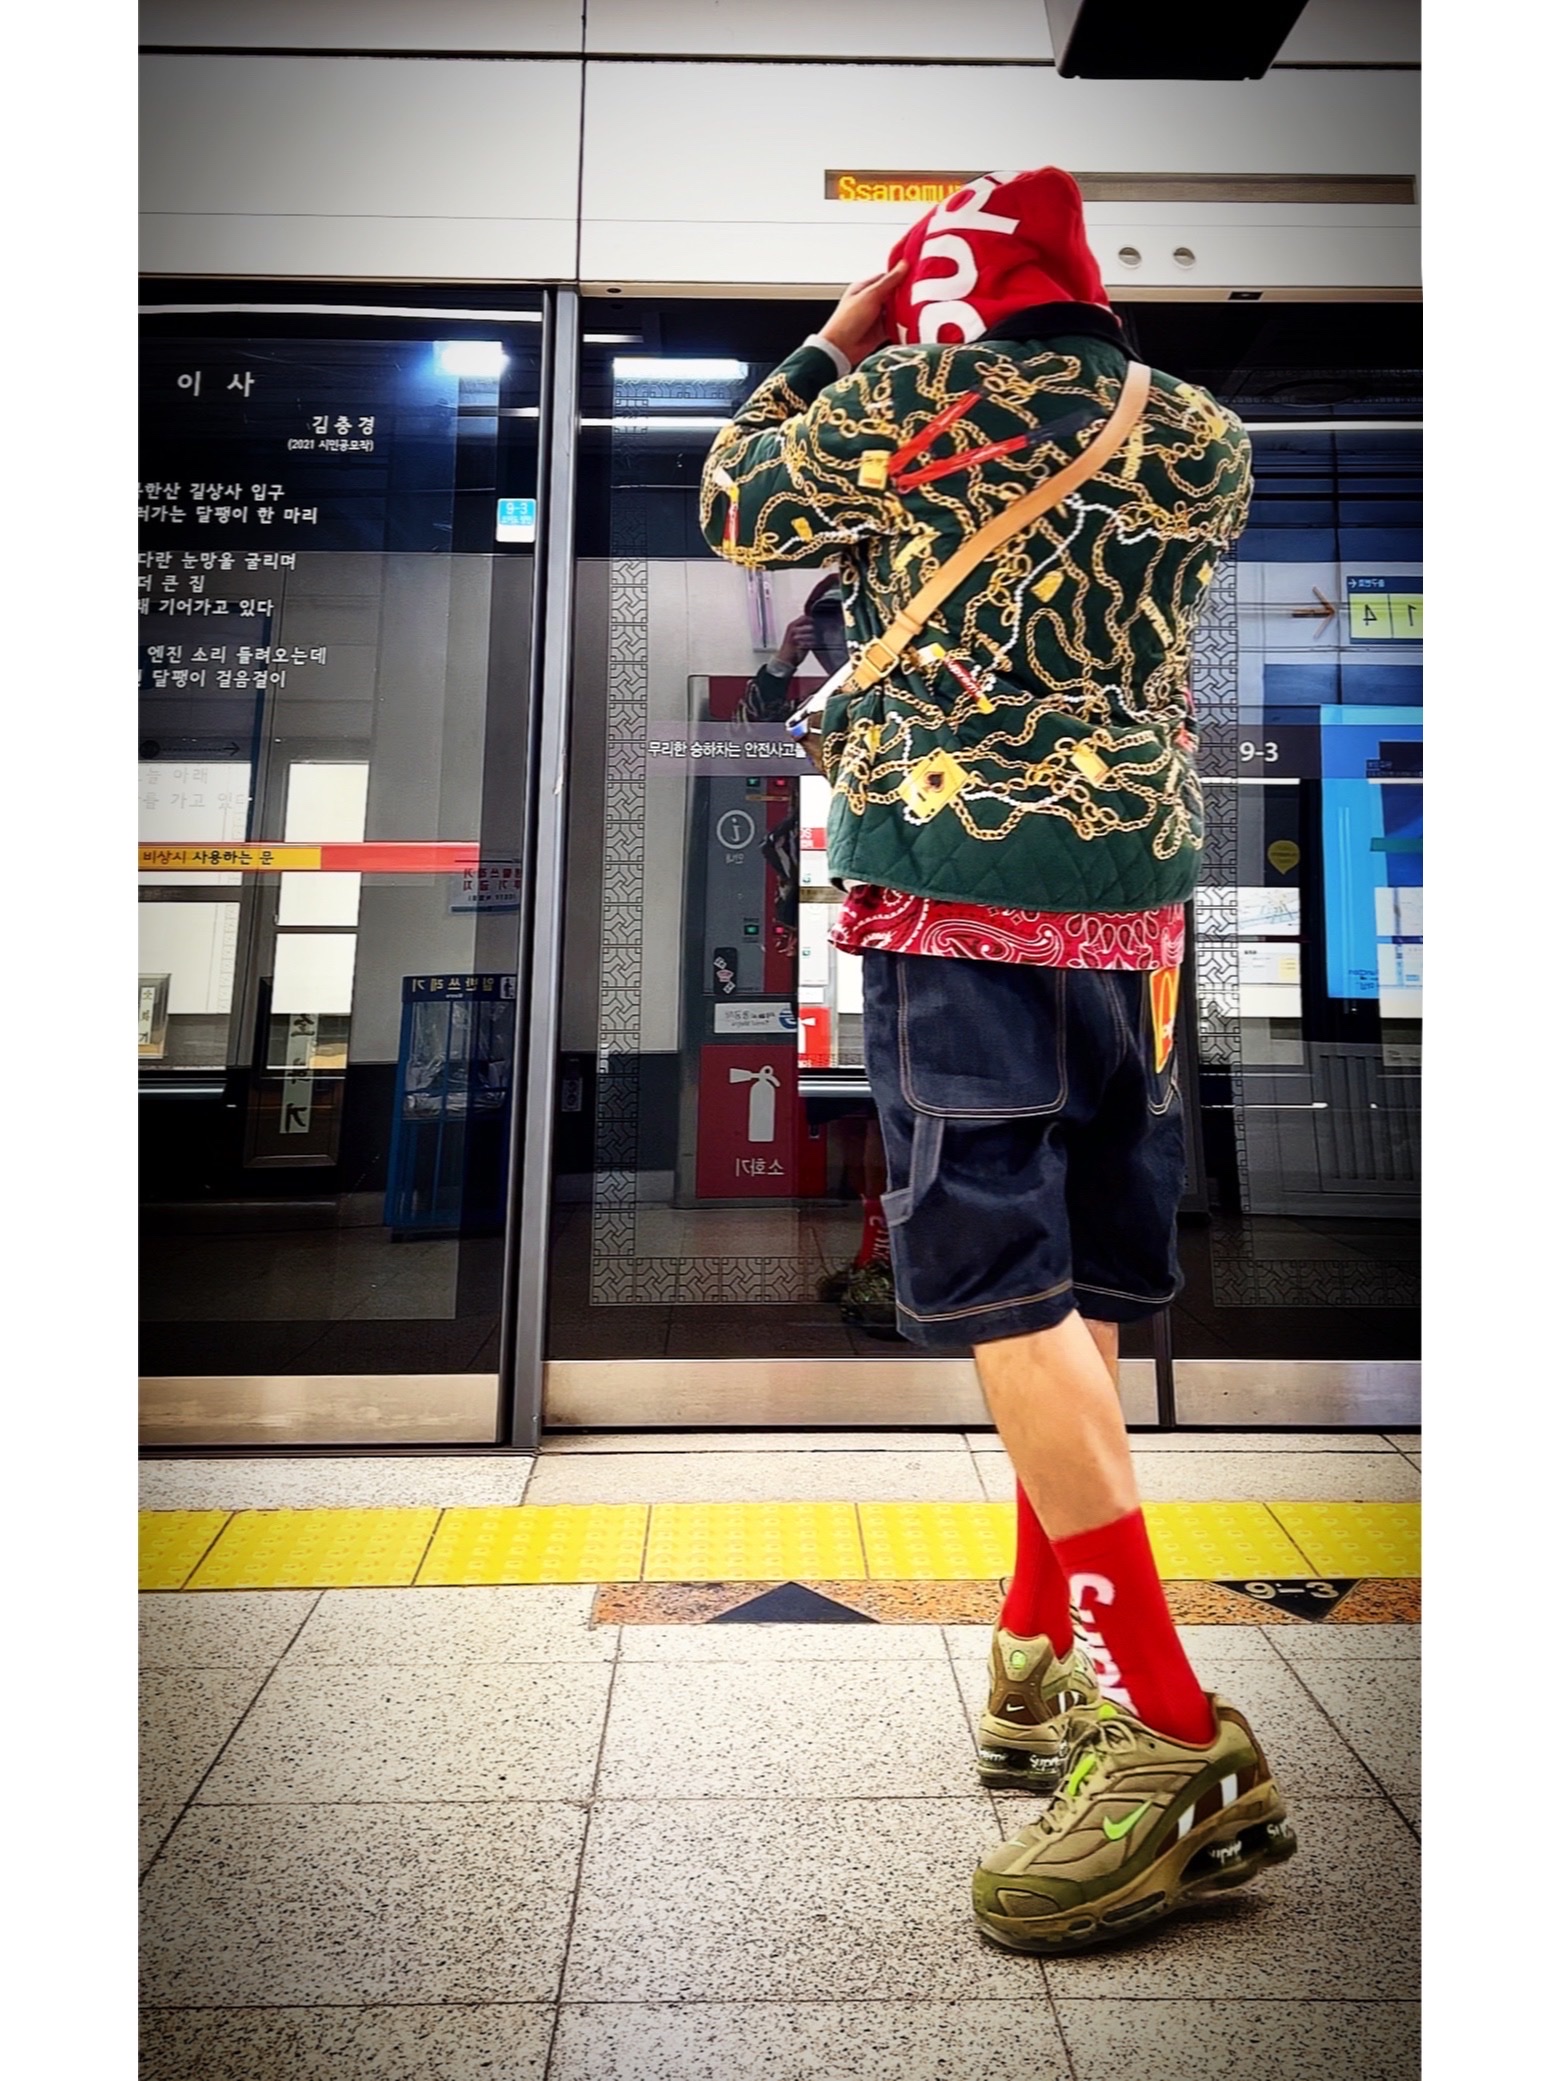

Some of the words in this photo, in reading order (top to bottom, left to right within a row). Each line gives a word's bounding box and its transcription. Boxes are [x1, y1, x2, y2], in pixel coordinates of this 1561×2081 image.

[177, 371, 200, 396] 이
[227, 372, 255, 397] 사
[287, 439, 315, 451] (2021
[190, 483, 242, 500] 길상사
[251, 483, 285, 501] 입구
[196, 506, 248, 524] 달팽이
[257, 506, 275, 524] 한
[283, 507, 318, 525] 마리
[181, 552, 235, 570] 눈망울
[244, 553, 296, 571] 굴리며
[161, 575, 179, 592] 큰
[189, 575, 205, 593] 집
[159, 598, 230, 616] 기어가고
[239, 599, 274, 617] 있다
[147, 645, 182, 664] 엔진
[191, 646, 226, 664] 소리
[236, 646, 327, 665] 들려오는데
[152, 669, 206, 688] 달팽이
[215, 670, 286, 689] 걸음걸이
[648, 741, 688, 758] 무리한
[690, 741, 741, 759] 승하차는
[1239, 741, 1278, 762] 9-3
[143, 851, 187, 865] 비상시
[191, 850, 253, 865] 사용하는
[259, 851, 275, 865] 문
[1244, 1581, 1340, 1600] 9-3
